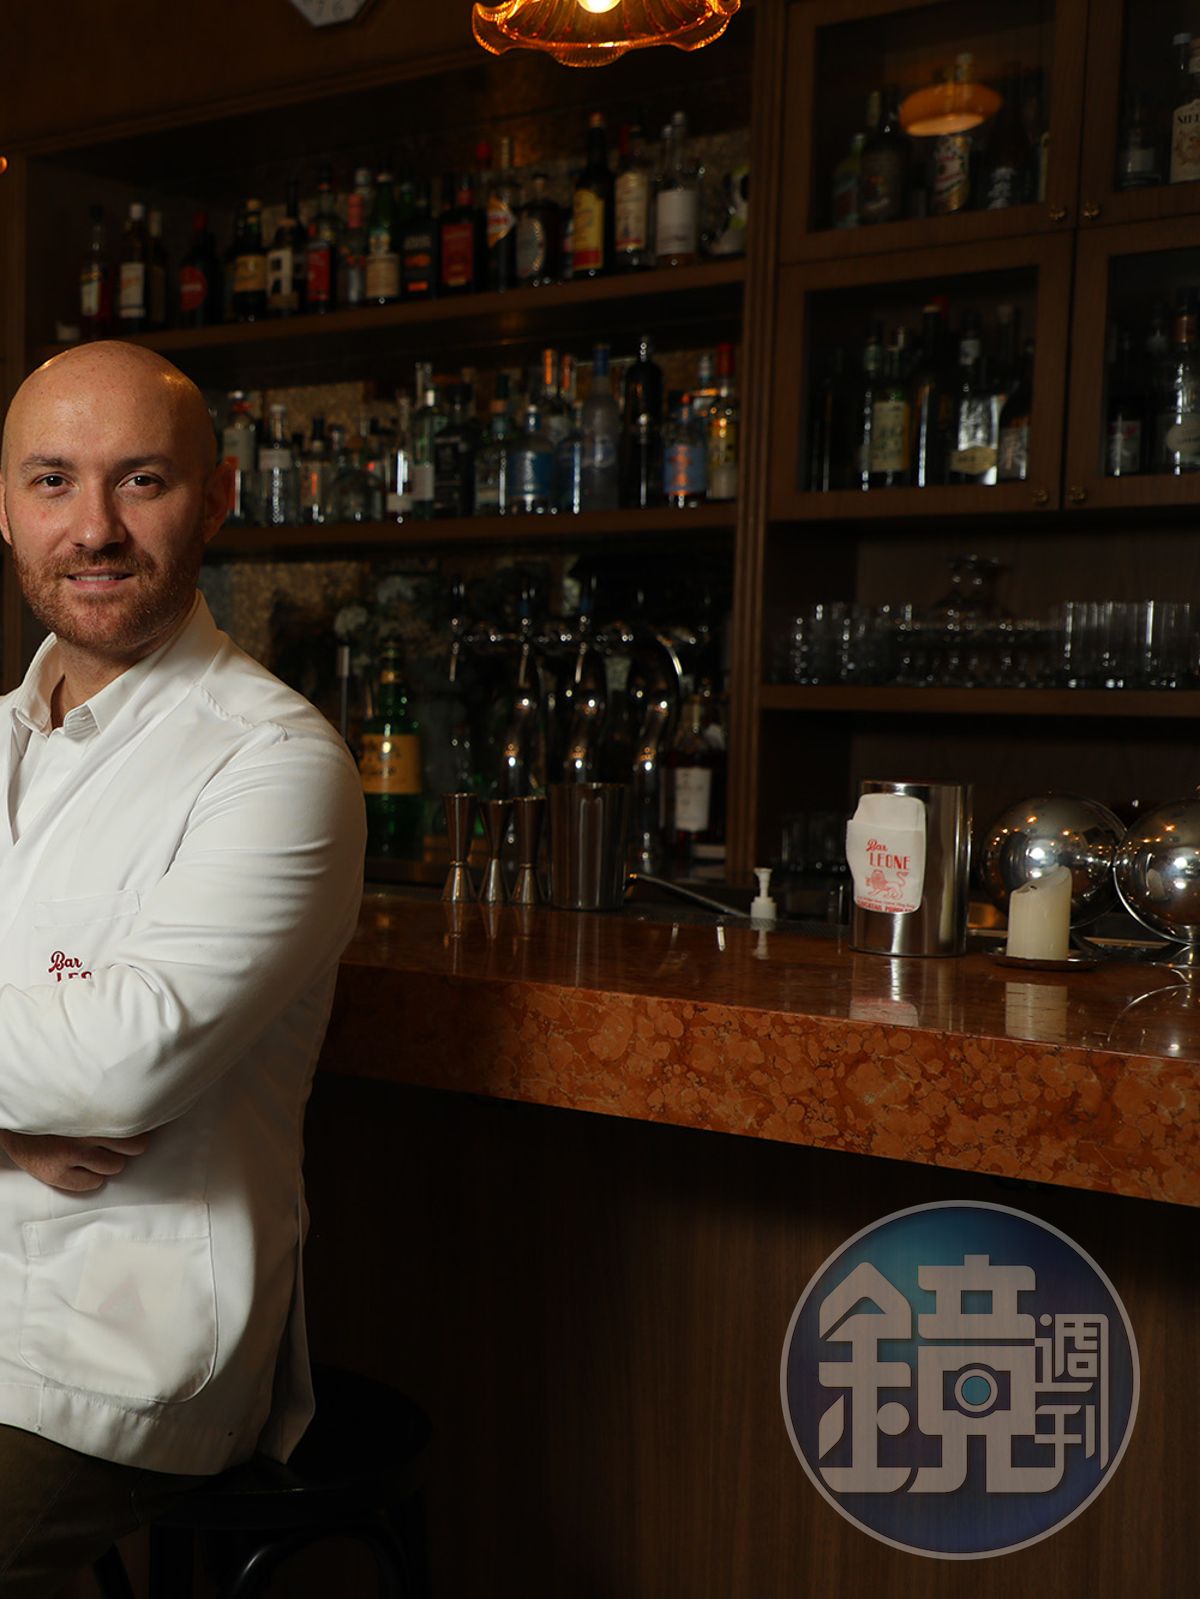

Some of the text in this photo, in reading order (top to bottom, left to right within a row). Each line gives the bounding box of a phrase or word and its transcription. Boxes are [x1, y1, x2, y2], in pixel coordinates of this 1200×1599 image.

[866, 839, 888, 852] Bar
[869, 852, 910, 869] LEONE
[48, 950, 83, 973] Bar
